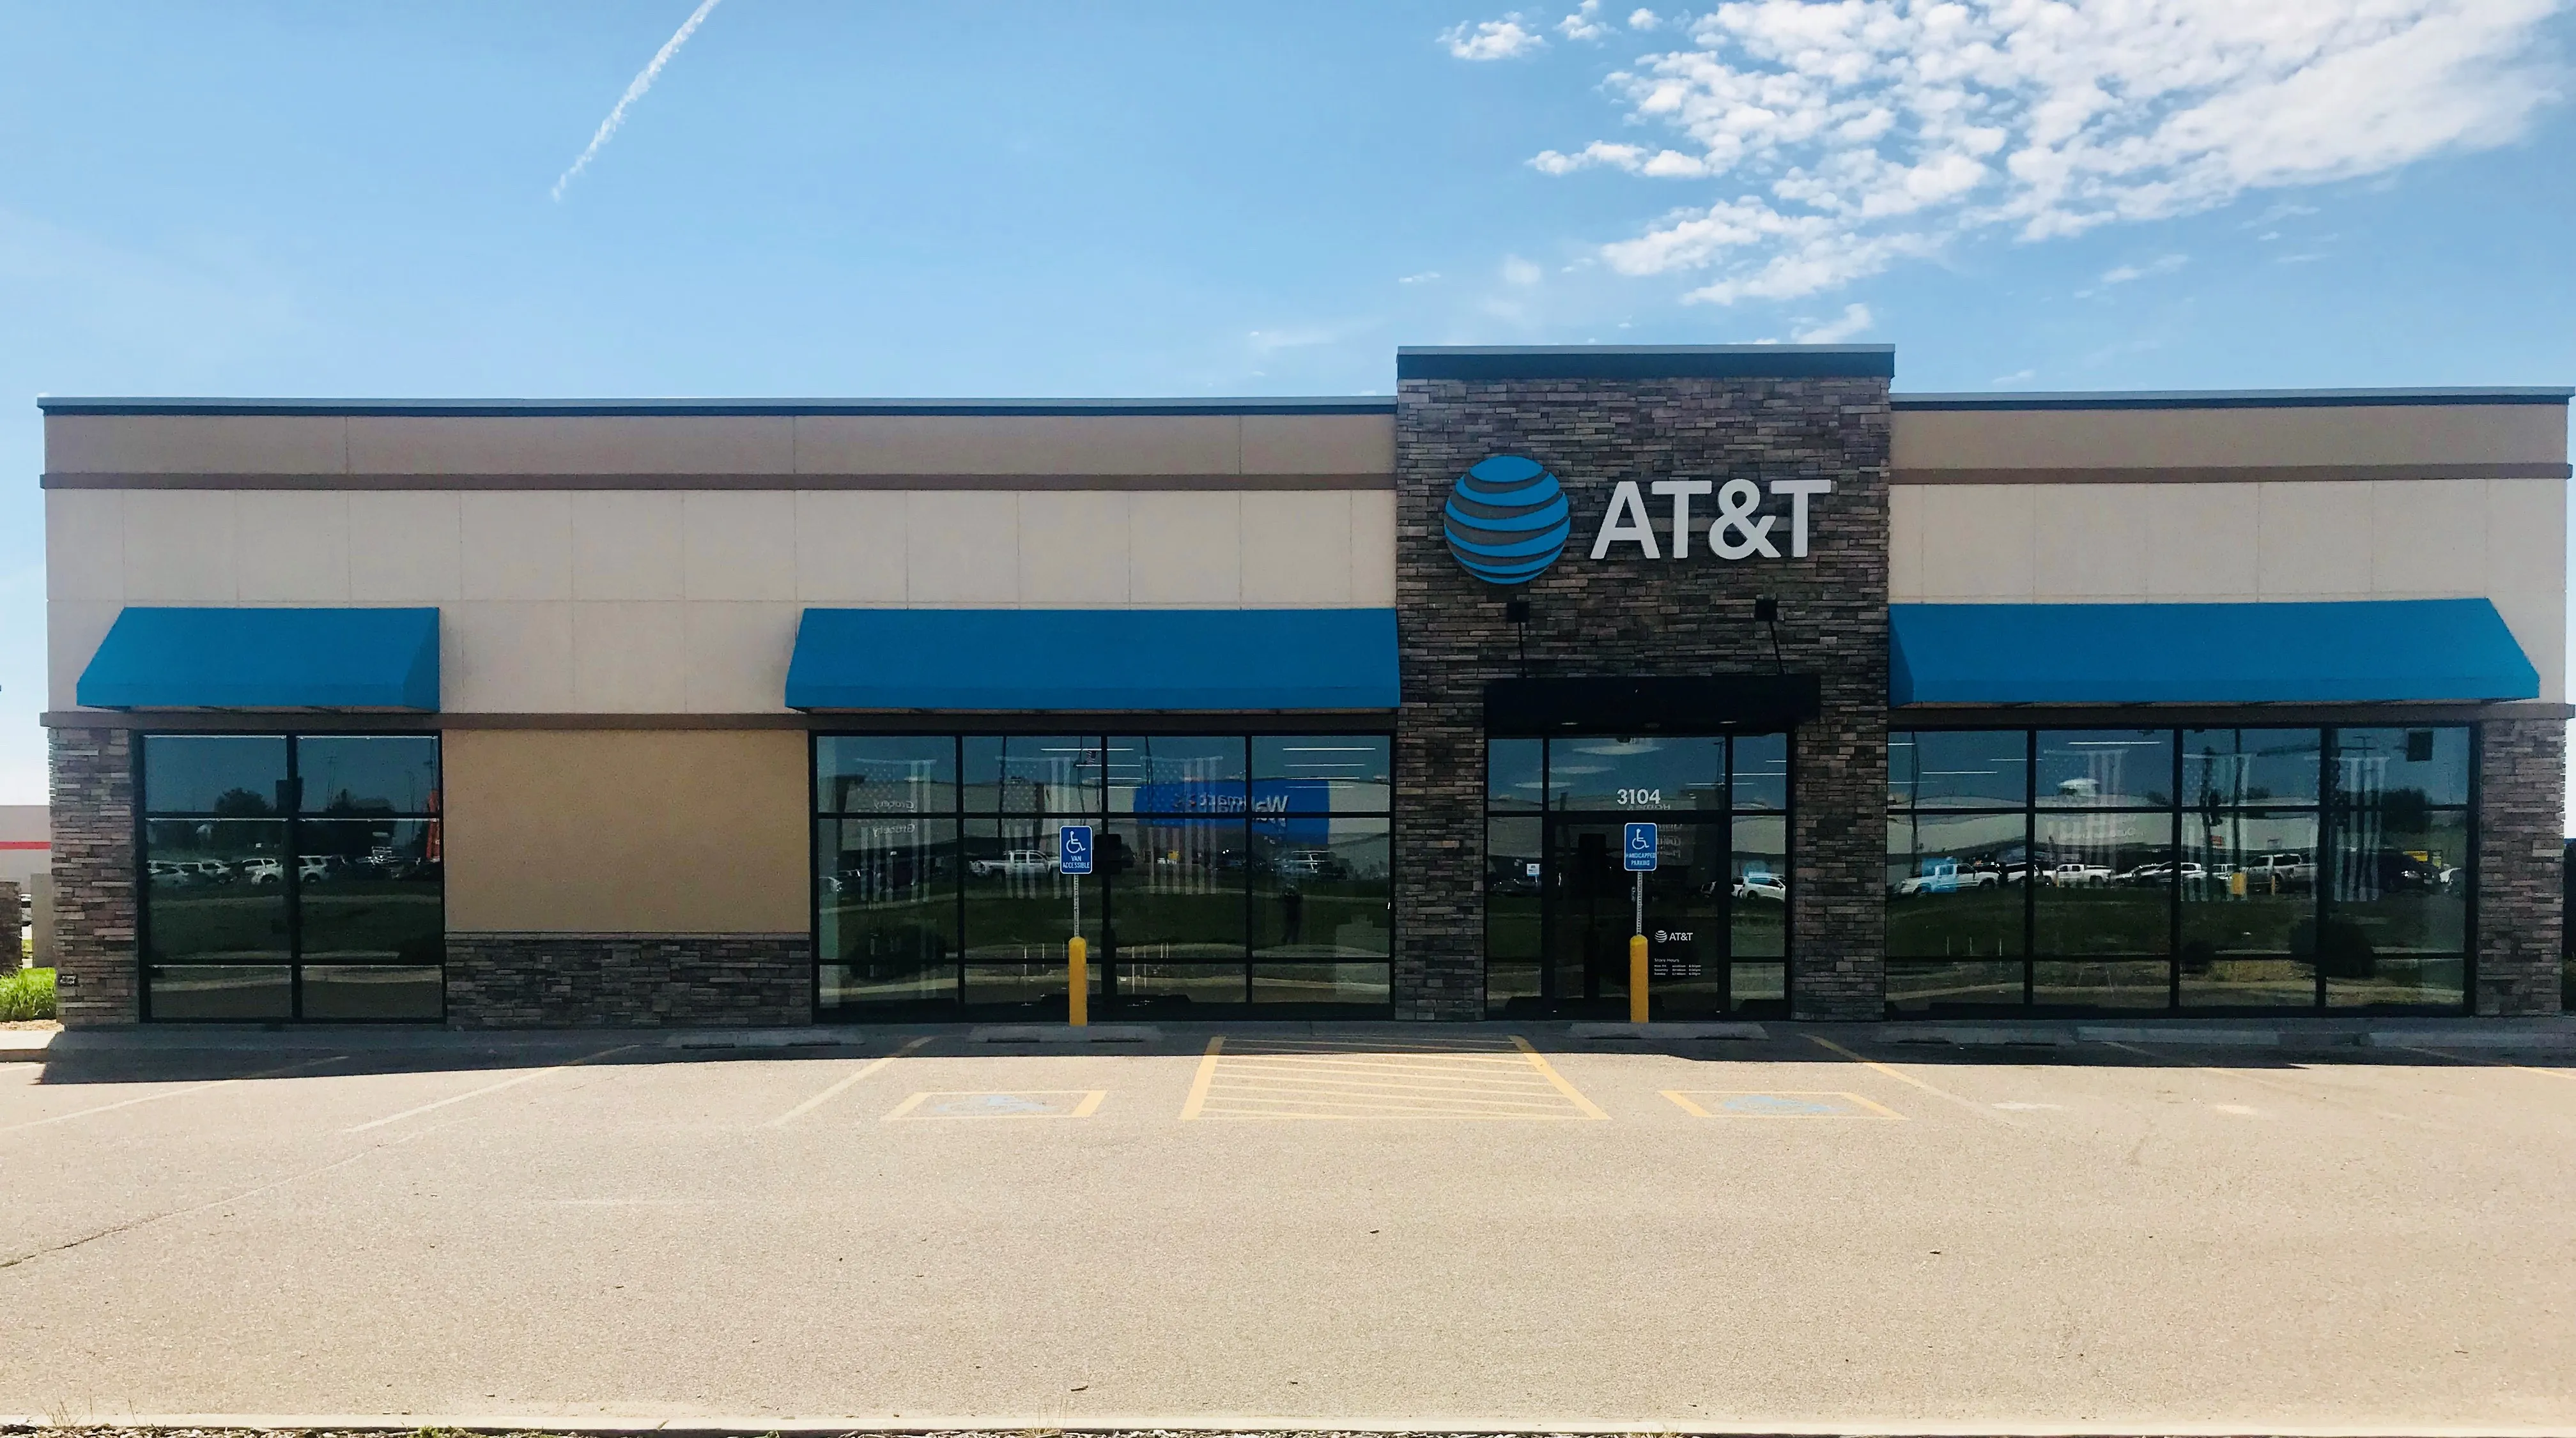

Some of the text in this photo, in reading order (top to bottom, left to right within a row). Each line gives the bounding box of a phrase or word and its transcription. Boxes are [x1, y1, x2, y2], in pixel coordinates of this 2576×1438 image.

[1590, 478, 1832, 560] AT&T
[1616, 788, 1661, 805] 3104
[1669, 932, 1693, 940] AT&T
